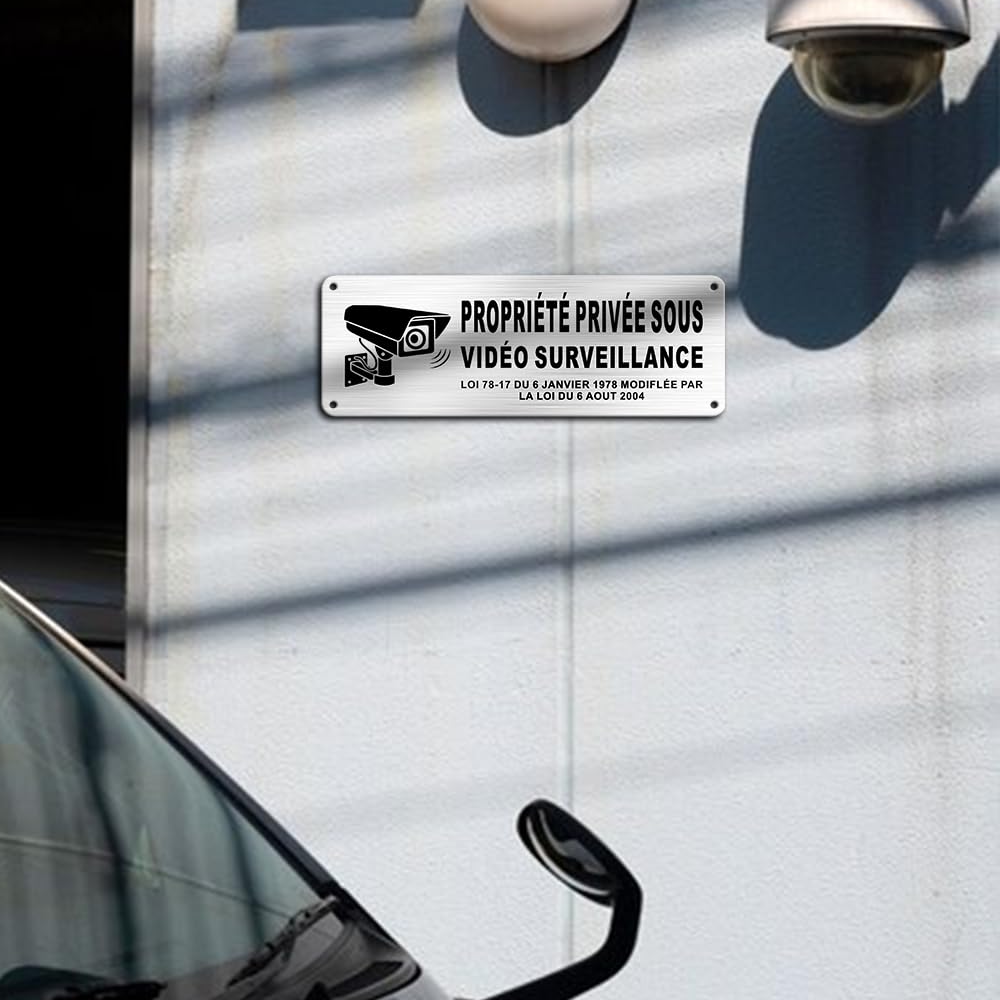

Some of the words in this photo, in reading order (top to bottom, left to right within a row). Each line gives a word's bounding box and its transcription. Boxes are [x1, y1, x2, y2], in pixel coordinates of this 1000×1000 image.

[461, 292, 570, 333] PROPRIÉTÉ
[575, 292, 646, 333] PRIVÉE
[650, 299, 704, 334] SOUS
[460, 340, 529, 369] VIDÉO
[534, 345, 704, 369] SURVEILLANCE
[460, 380, 480, 389] LOI
[482, 380, 511, 389] 78-17
[514, 380, 530, 389] DU
[532, 380, 539, 389] 6
[541, 380, 590, 389] JANVIER
[592, 380, 618, 389] 1978
[680, 380, 703, 389] PAR
[519, 391, 534, 401] LA
[536, 391, 555, 401] LOI
[558, 391, 574, 401] DU
[576, 391, 583, 401] 6
[585, 391, 617, 401] AOUT
[619, 391, 645, 401] 2004
